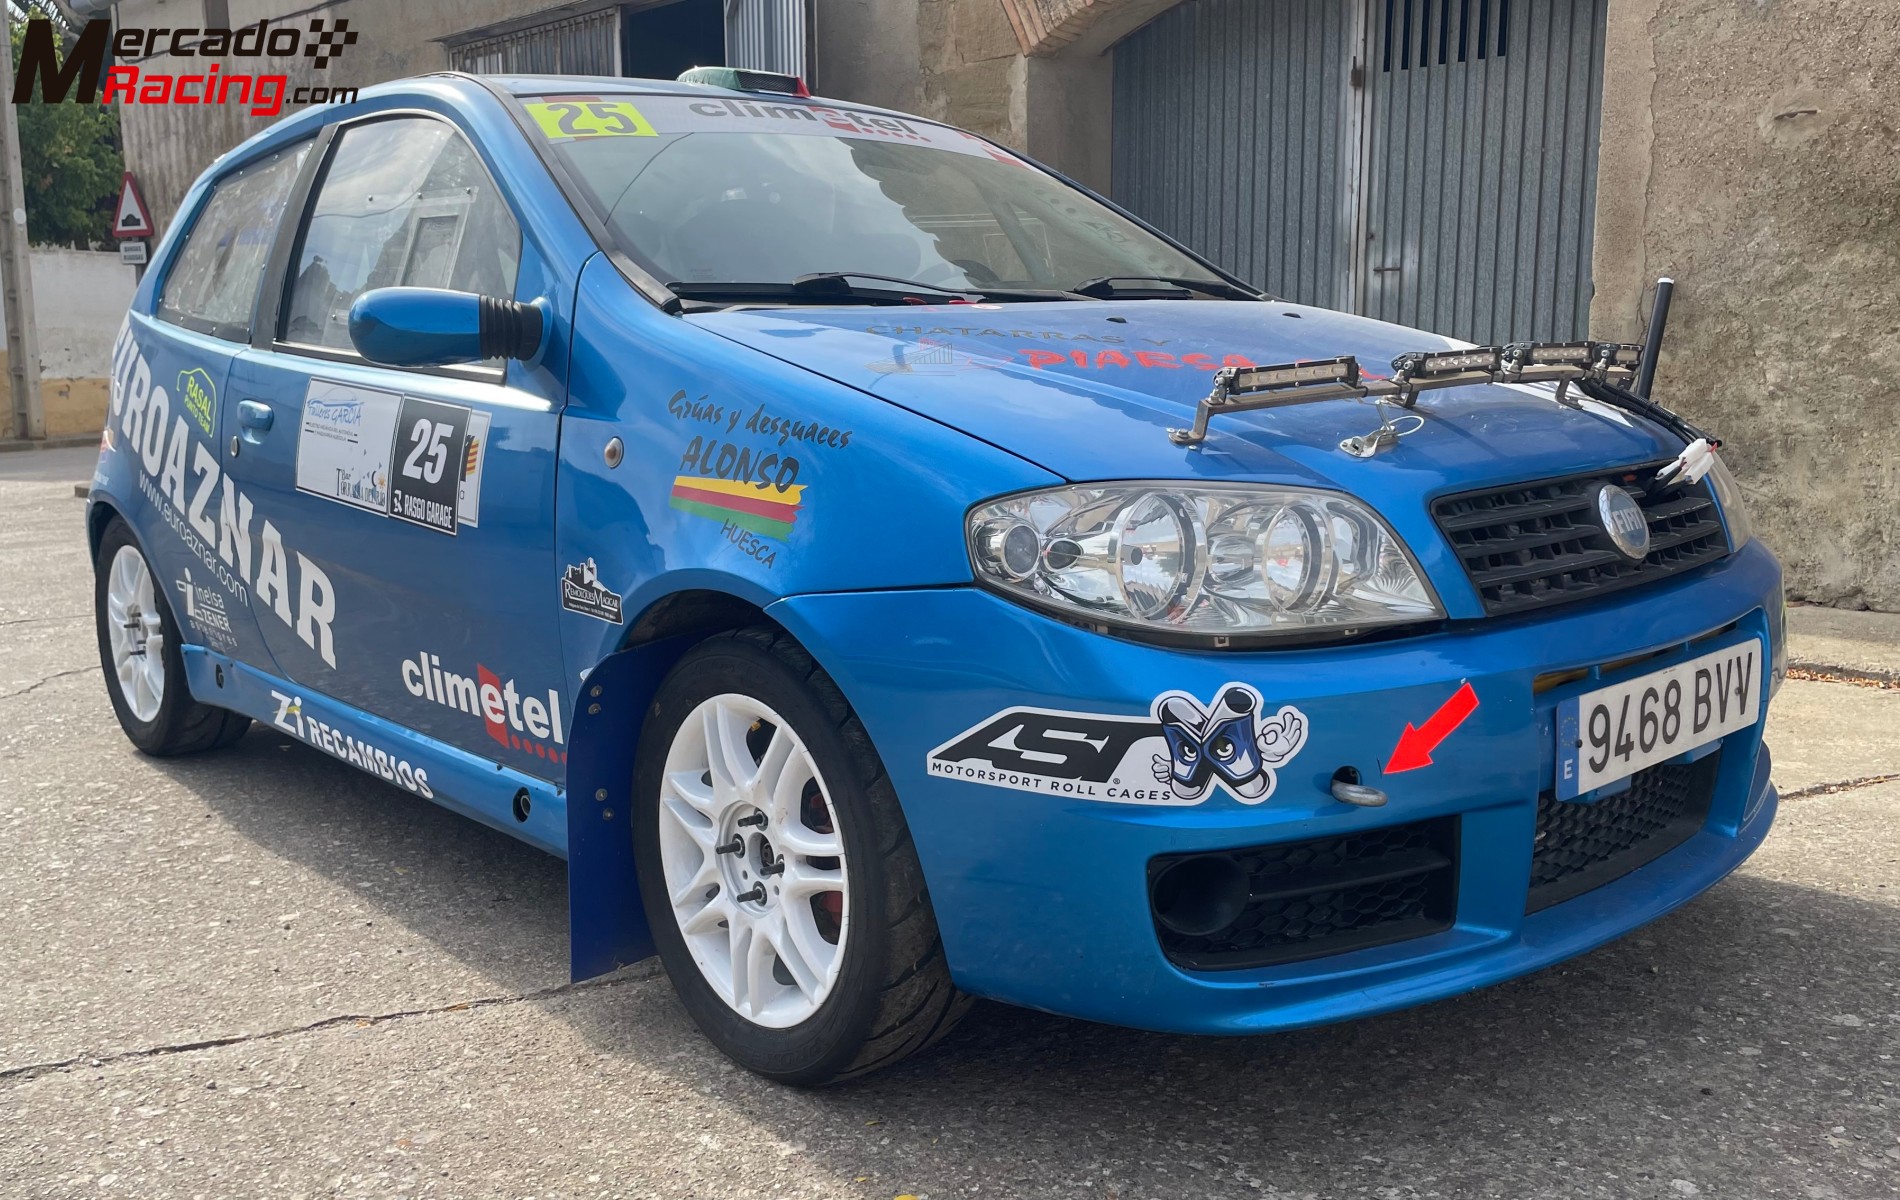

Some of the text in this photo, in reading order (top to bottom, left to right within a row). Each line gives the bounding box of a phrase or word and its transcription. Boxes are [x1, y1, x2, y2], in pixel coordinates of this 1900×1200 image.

[546, 102, 639, 136] 25
[688, 99, 920, 136] climetel
[865, 325, 1125, 345] CHATARRAS
[186, 375, 211, 421] RASAL
[668, 389, 853, 449] Grúas y desguaces
[402, 418, 455, 484] 25
[678, 435, 801, 494] ALONSO
[426, 500, 453, 529] GARAGE
[1611, 507, 1643, 534] FIAT
[138, 469, 249, 608] www.euroaznar.com
[719, 517, 777, 569] HUESCA
[194, 581, 225, 609] inelsa
[401, 650, 565, 745] climetel
[1587, 652, 1753, 774] 9468 BVV
[306, 715, 434, 800] RECAMBIOS
[1563, 758, 1573, 780] E
[932, 762, 1172, 801] MOTORSPORT ROLL CAGES
